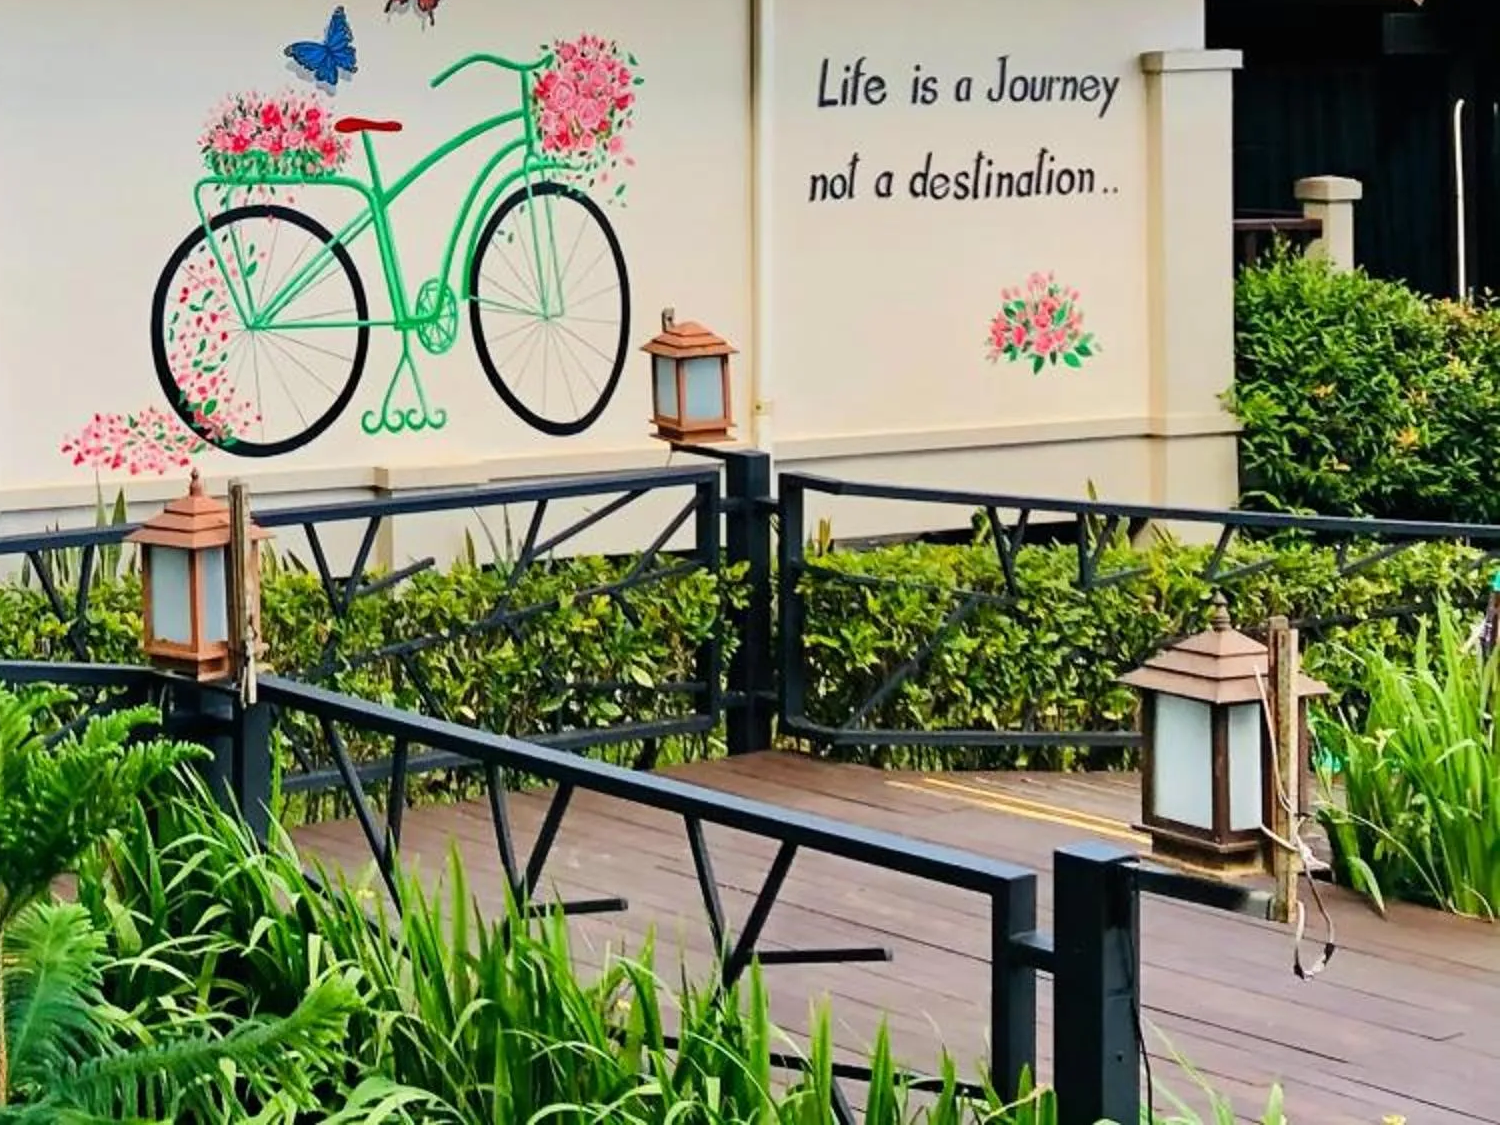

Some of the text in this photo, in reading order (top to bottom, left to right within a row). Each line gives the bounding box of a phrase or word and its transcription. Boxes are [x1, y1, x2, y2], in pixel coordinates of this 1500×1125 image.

[817, 54, 1122, 120] Life is a Journey
[808, 151, 861, 202] not
[874, 169, 895, 200] a
